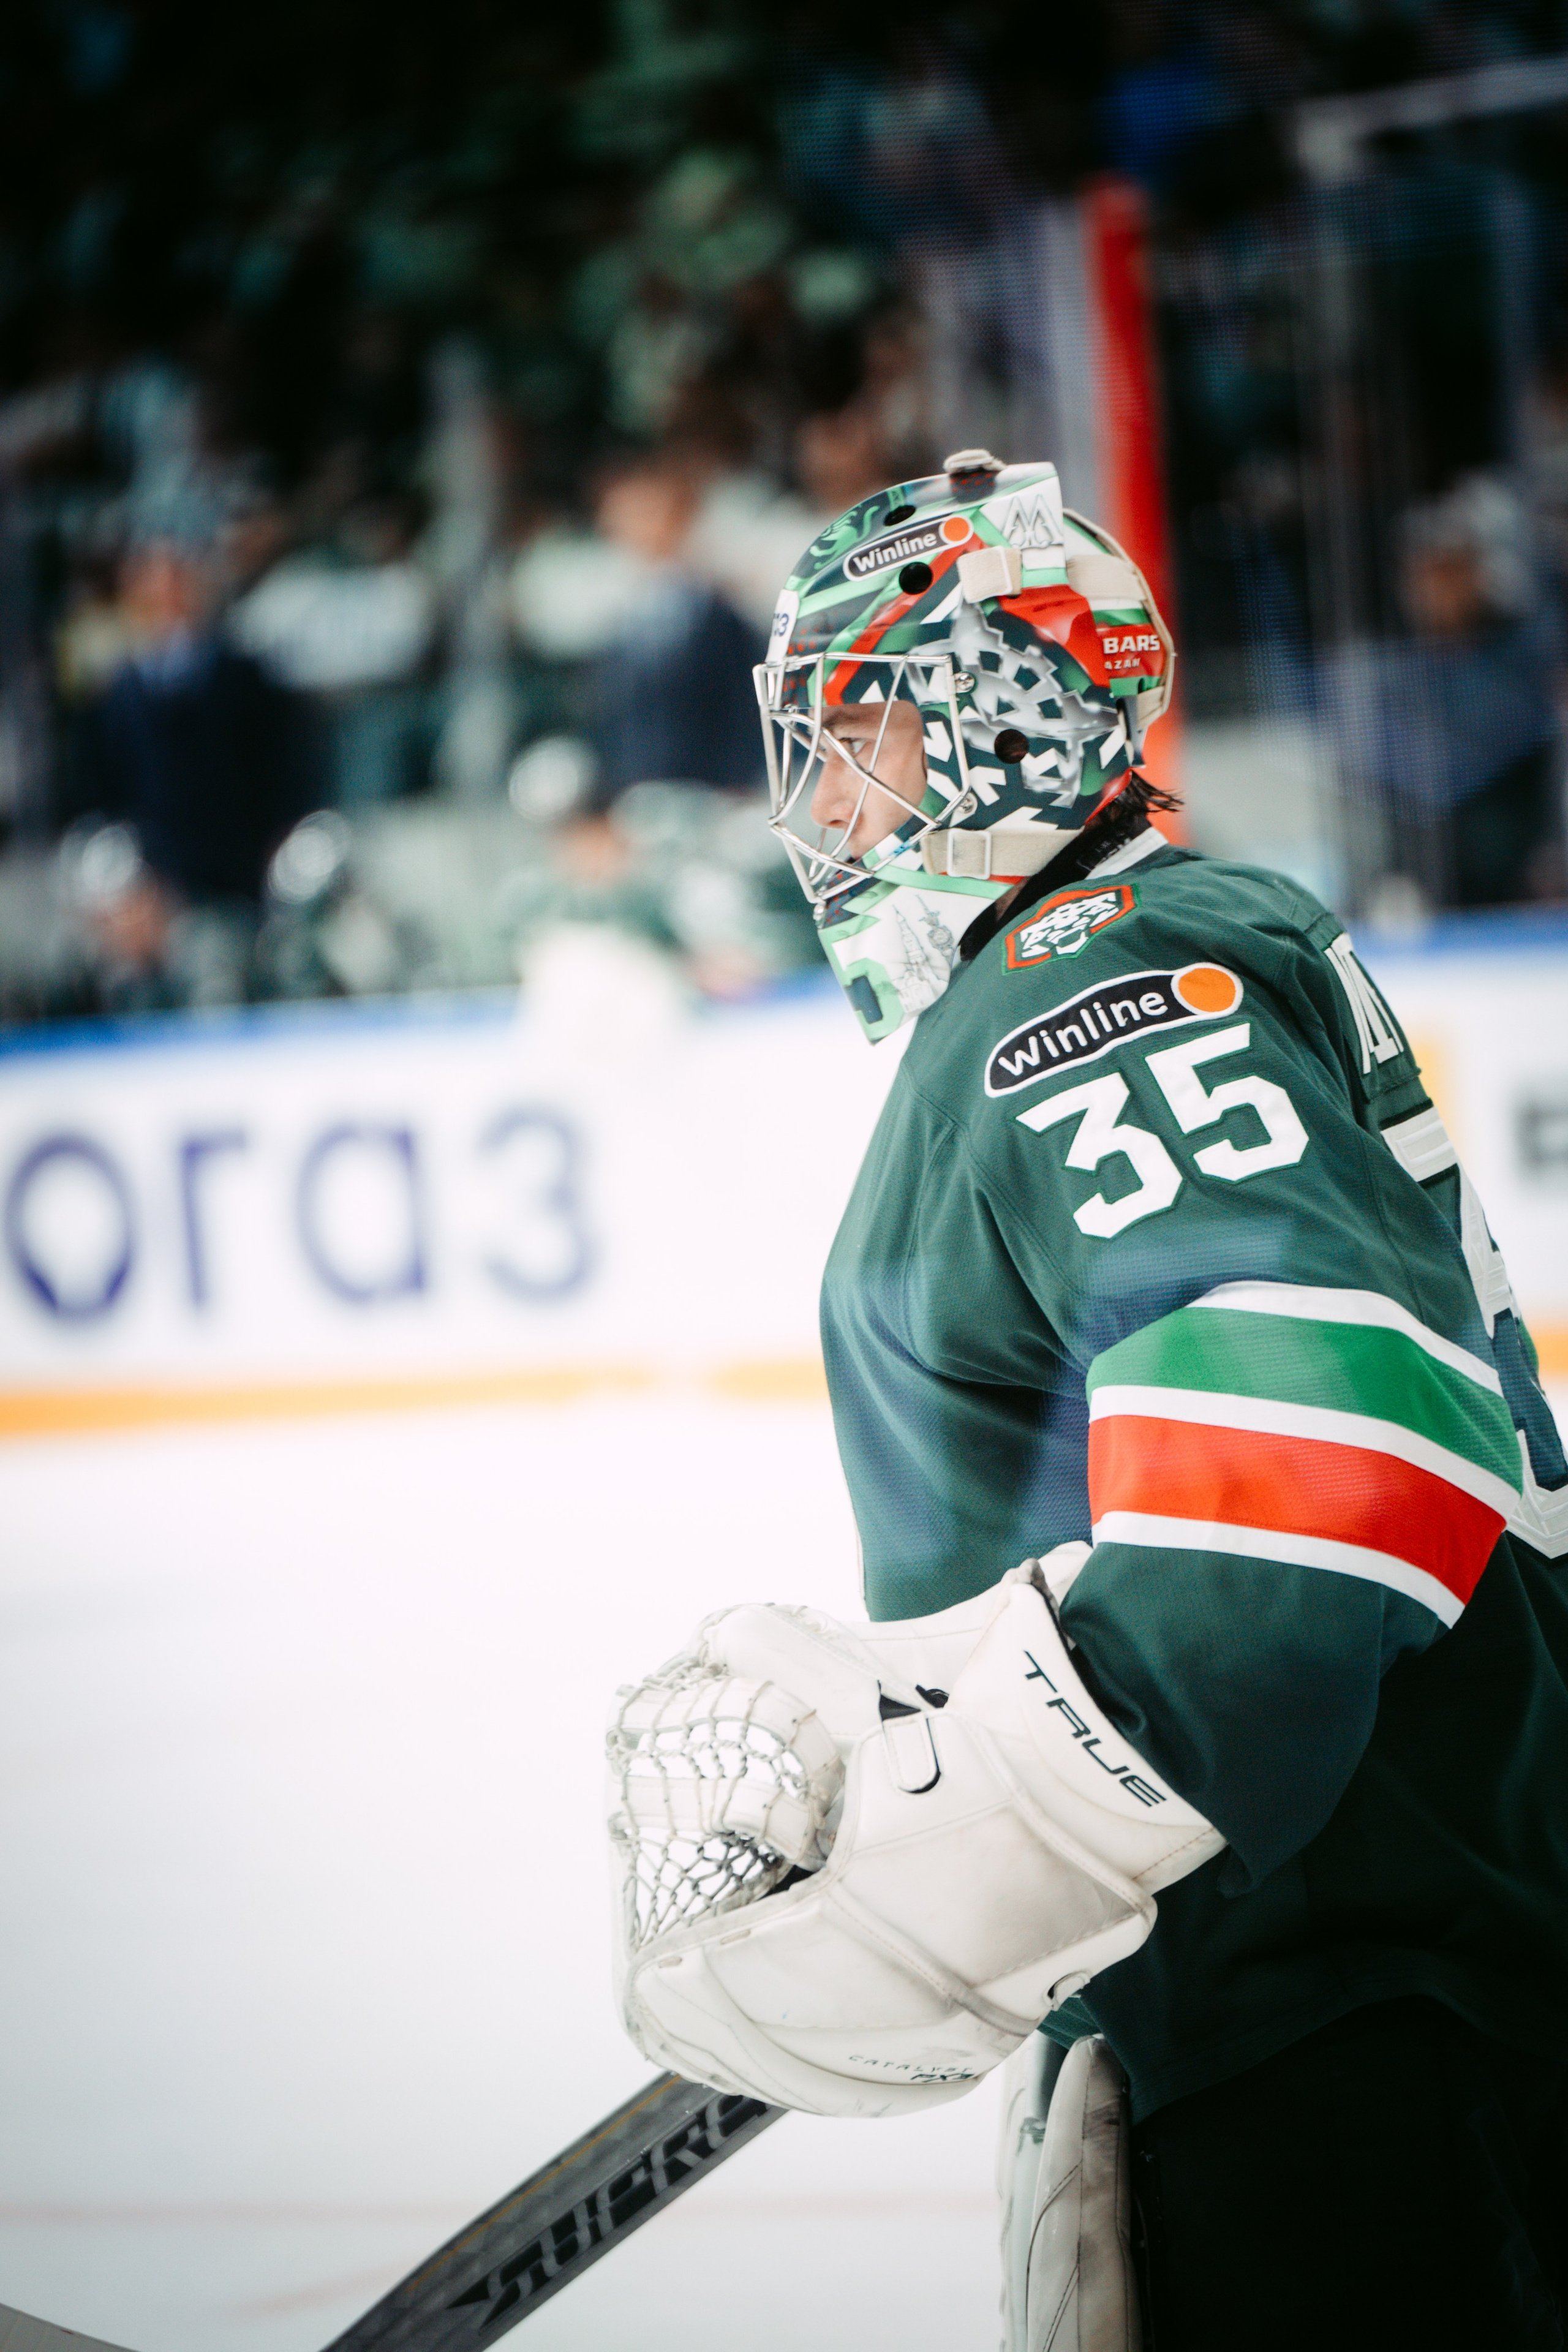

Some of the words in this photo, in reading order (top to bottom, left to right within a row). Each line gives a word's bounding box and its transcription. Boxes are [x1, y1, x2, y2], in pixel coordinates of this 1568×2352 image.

[853, 533, 937, 572] Winline
[1103, 635, 1160, 654] BARS
[998, 992, 1168, 1076] Winline
[1015, 1022, 1310, 1239] 35
[1023, 1650, 1167, 1807] TRUE
[452, 2094, 769, 2335] SUPRE
